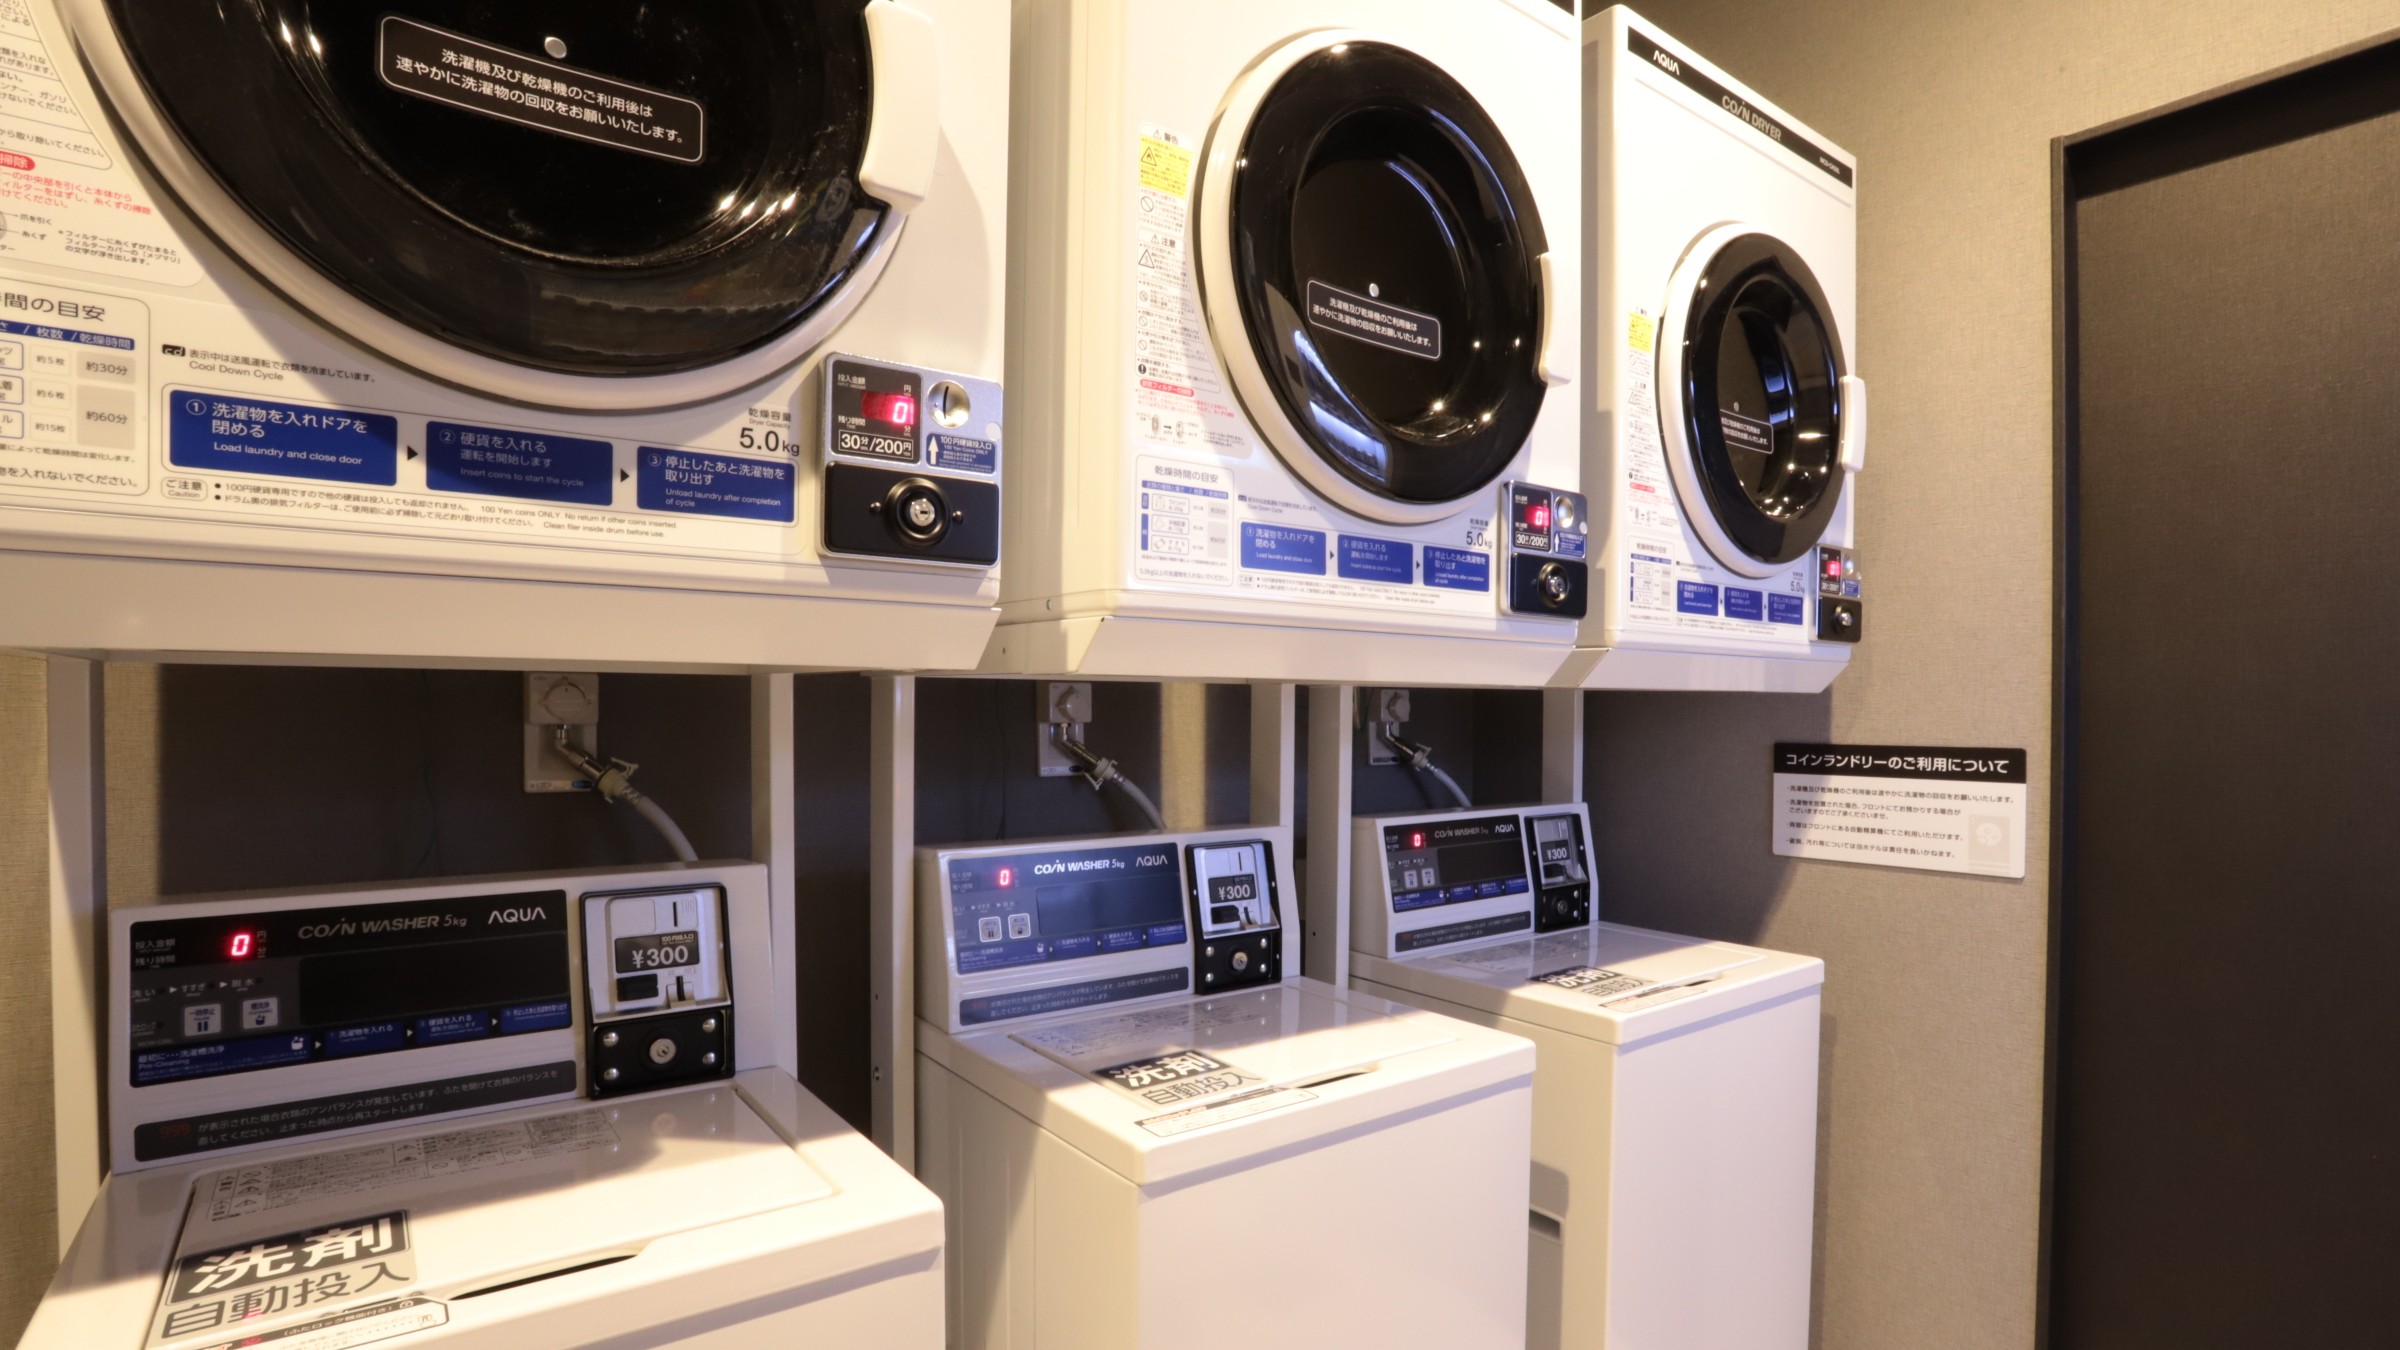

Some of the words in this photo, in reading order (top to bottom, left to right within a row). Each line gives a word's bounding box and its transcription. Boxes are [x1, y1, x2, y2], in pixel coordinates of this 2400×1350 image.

[1653, 50, 1680, 75] AQUA
[442, 48, 653, 118] 洗濯機及び乾燥機のご利用後は
[396, 55, 683, 144] 速やかに洗濯物の回収をお願いいたします。
[1752, 113, 1782, 141] DRYER
[0, 291, 105, 321] 間の目安
[80, 332, 131, 349] 乾燥時間
[86, 361, 128, 376] 約30分
[190, 361, 216, 372] Cool
[219, 364, 250, 376] Down
[253, 367, 284, 382] Cycle
[86, 410, 128, 424] 約60分
[212, 402, 368, 434] 洗濯物を入れドアを
[749, 408, 792, 422] 乾燥容量
[893, 402, 908, 423] 0
[212, 419, 266, 439] 閉める
[214, 442, 241, 453] Load
[244, 444, 283, 459] laundry
[287, 448, 306, 458] and
[309, 450, 336, 461] close
[340, 453, 362, 465] door
[460, 432, 547, 454] 硬貨を入れる
[460, 449, 552, 469] 運転を開始します
[665, 455, 785, 480] 停止したあと洗濯物を
[460, 466, 486, 478] Insert
[488, 469, 511, 480] coins
[513, 472, 522, 481] to
[524, 473, 544, 483] start
[546, 474, 559, 484] the
[562, 477, 584, 488] cycle
[665, 470, 715, 486] 取り出す
[1155, 465, 1219, 483] 乾燥時間の目安
[665, 487, 693, 498] Unload
[694, 490, 722, 503] laundry
[723, 493, 741, 503] after
[743, 495, 781, 507] completion
[665, 498, 674, 506] of
[675, 499, 695, 510] cycle
[515, 508, 536, 517] coins
[607, 517, 625, 525] other
[627, 519, 647, 527] coins
[1255, 528, 1316, 544] 洗濯物を入れドアを
[1787, 753, 2010, 774] コインランドリーのご利用について
[1413, 834, 1421, 847] 0
[1454, 827, 1480, 837] WASHER
[1495, 824, 1515, 834] AQUA
[1547, 847, 1567, 861] ¥300
[1034, 859, 1065, 875] COIN
[1068, 860, 1109, 873] WASHER
[1112, 859, 1125, 870] 5kg
[1136, 855, 1168, 868] AQUA
[1000, 869, 1010, 885] 0
[1218, 884, 1251, 901] ¥300
[298, 918, 346, 940] COIN
[361, 914, 439, 934] WASHER
[443, 914, 467, 928] 5kg
[488, 906, 547, 925] AQUA
[231, 934, 250, 957] 0
[632, 945, 688, 968] ¥300
[1109, 1052, 1220, 1087] 洗剤
[1142, 1071, 1262, 1105] 自動投入
[188, 1218, 395, 1294] 洗剤
[161, 1261, 410, 1339] 自動投入
